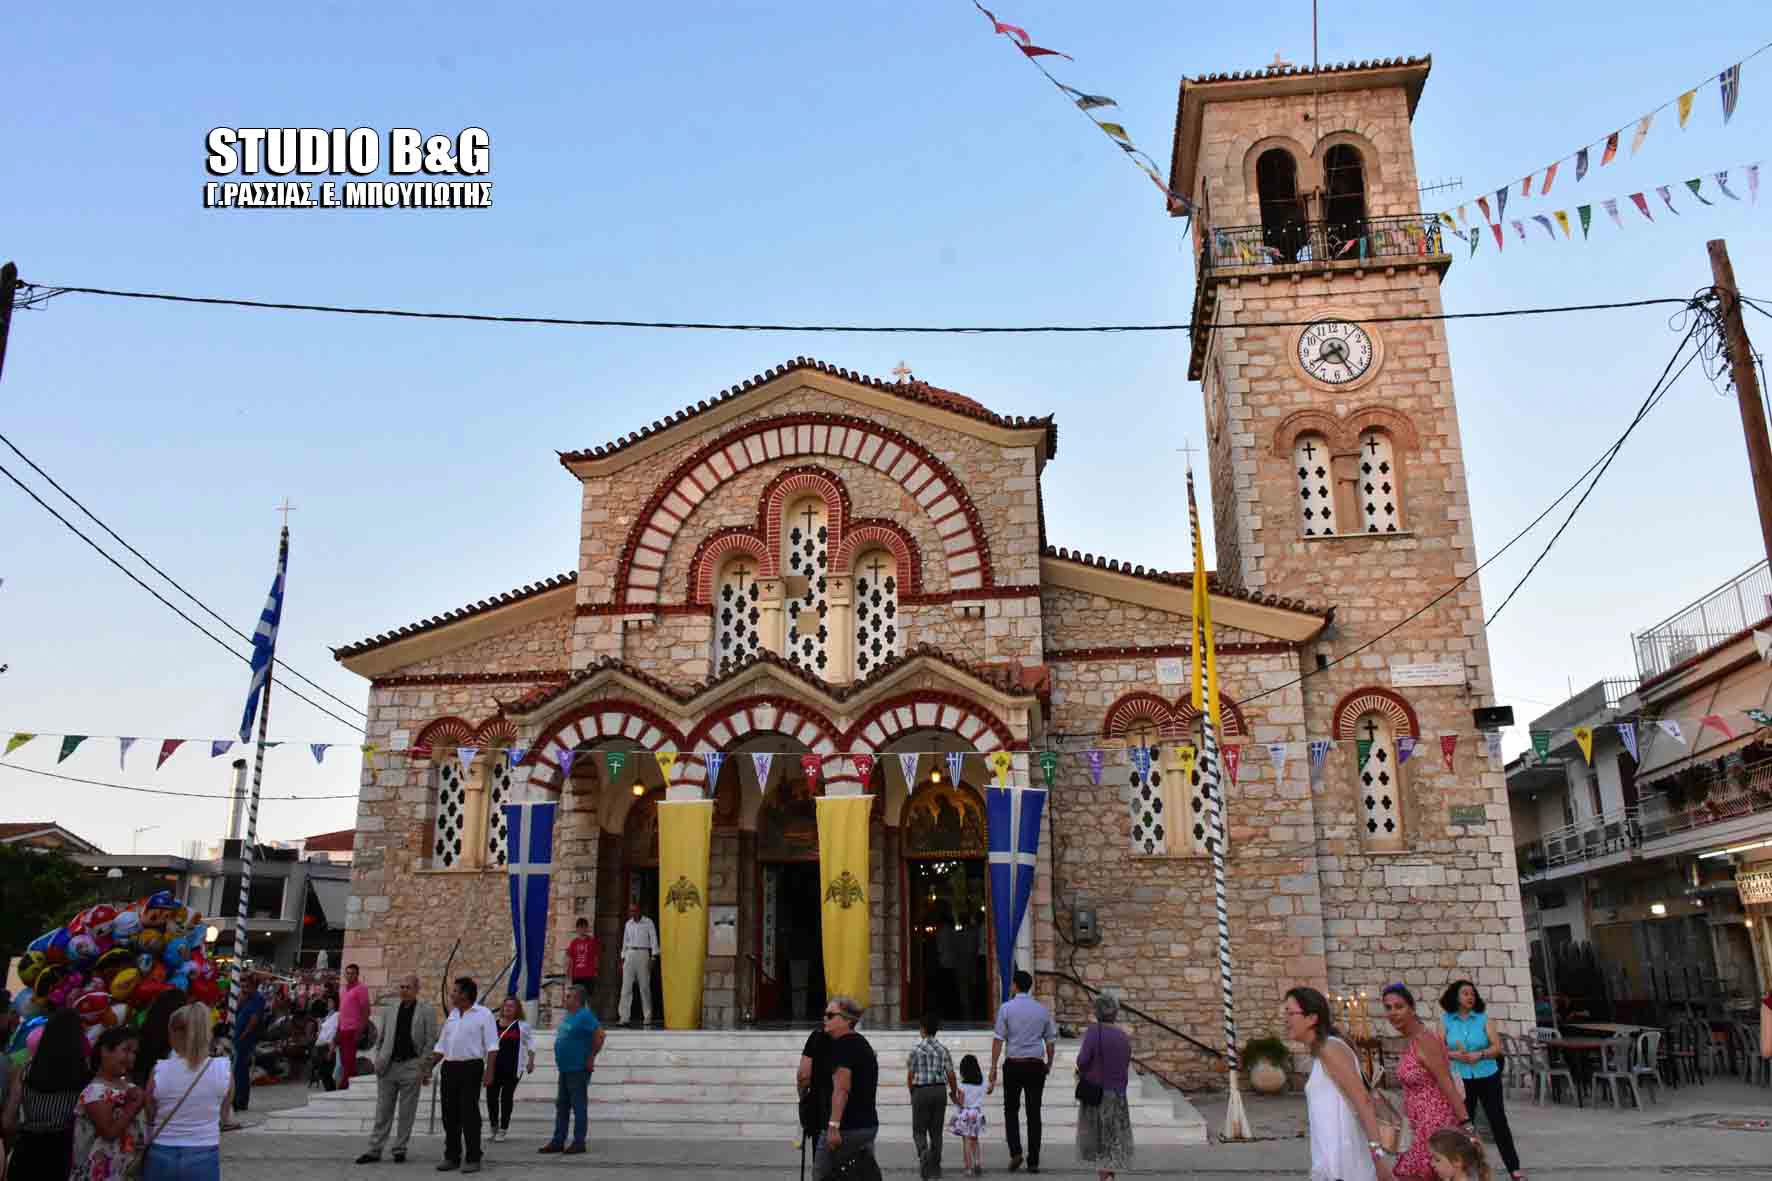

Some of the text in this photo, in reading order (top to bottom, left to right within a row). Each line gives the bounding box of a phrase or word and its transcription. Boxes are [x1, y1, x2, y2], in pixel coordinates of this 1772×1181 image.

[1317, 326, 1325, 336] 11
[1328, 323, 1338, 333] 12
[1344, 325, 1348, 334] 1
[1307, 336, 1316, 345] 10
[1355, 334, 1361, 343] 2
[1303, 348, 1309, 357] 9
[1361, 345, 1367, 354] 3
[1334, 370, 1340, 380] 6
